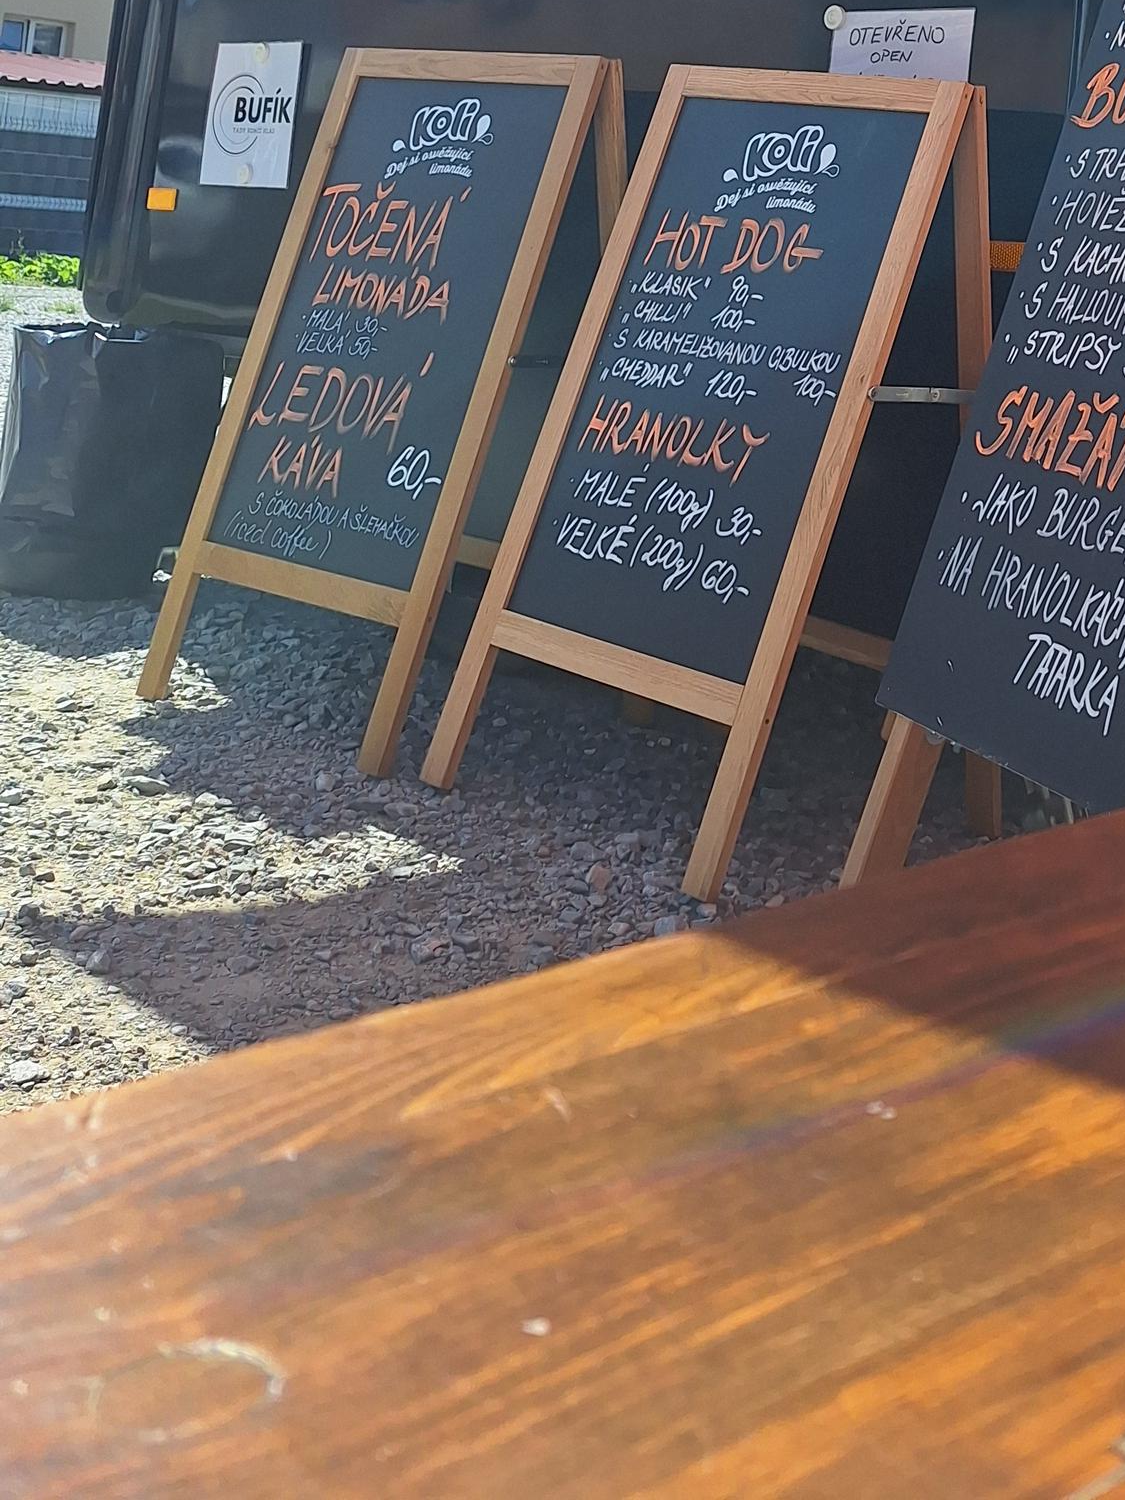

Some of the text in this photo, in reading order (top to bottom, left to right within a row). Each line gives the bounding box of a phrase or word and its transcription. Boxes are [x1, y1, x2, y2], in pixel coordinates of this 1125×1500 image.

[849, 18, 946, 47] OTEVŘENO
[870, 49, 914, 64] OPEN
[234, 87, 293, 124] BUFÍK
[384, 157, 408, 179] Dej
[408, 152, 421, 166] si
[428, 163, 473, 178] limonádu
[1070, 148, 1091, 179] S
[714, 188, 741, 213] Dej
[741, 183, 756, 199] si
[765, 196, 817, 214] limonádu
[308, 180, 472, 271] TOČENÁ
[643, 208, 824, 274] HOT DOG
[1040, 236, 1062, 273] S
[311, 262, 451, 326] LIMONÁDA
[727, 275, 765, 308] 90,-
[1024, 281, 1048, 320] S
[355, 316, 388, 338] 30,-
[711, 305, 756, 333] 100,-
[296, 329, 352, 356] VELKÁ
[613, 328, 629, 349] S
[767, 345, 842, 375] CIBULKOU
[248, 351, 436, 457] LEDOVÁ
[704, 370, 758, 406] 120,-
[577, 393, 771, 488] HRANOLKY
[256, 433, 442, 501] KÁVA 60,-
[248, 491, 265, 514] S
[337, 506, 351, 529] A
[349, 504, 420, 549] ŠLEHAČKOU
[573, 463, 648, 508] MALÉ
[715, 507, 764, 546] 30,-
[972, 473, 1038, 535] JAKO
[555, 512, 638, 565] VELKÉ
[701, 558, 750, 605] 60,-
[939, 534, 984, 597] NA
